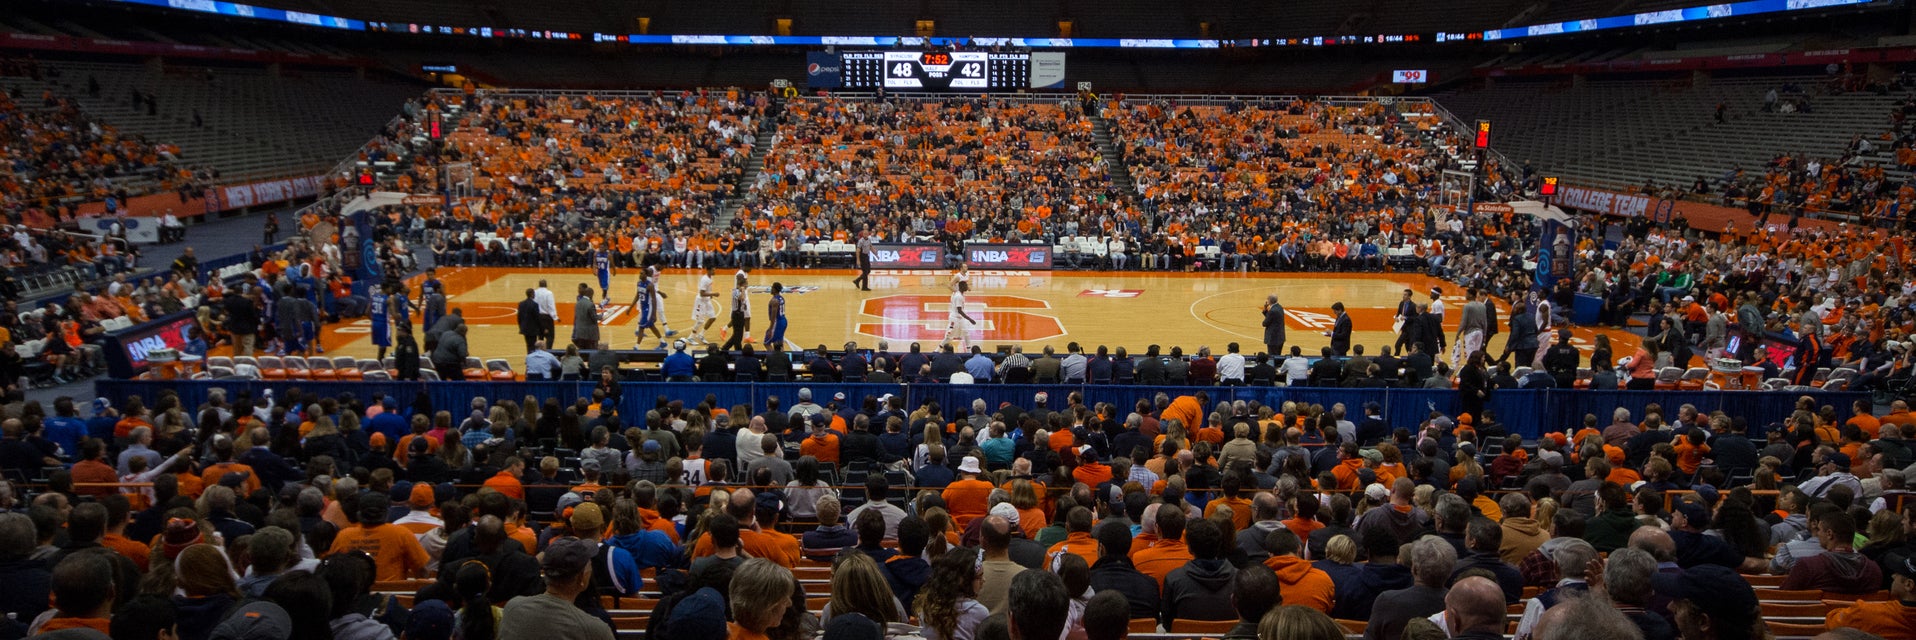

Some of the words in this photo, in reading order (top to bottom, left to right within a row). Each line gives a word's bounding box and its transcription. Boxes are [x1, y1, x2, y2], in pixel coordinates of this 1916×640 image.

[925, 55, 948, 64] 7:52
[893, 63, 912, 77] 48
[961, 63, 981, 77] 42
[1565, 187, 1613, 212] COLLEGE
[1614, 193, 1649, 217] TEAM
[371, 301, 384, 314] 31
[682, 470, 701, 486] 34
